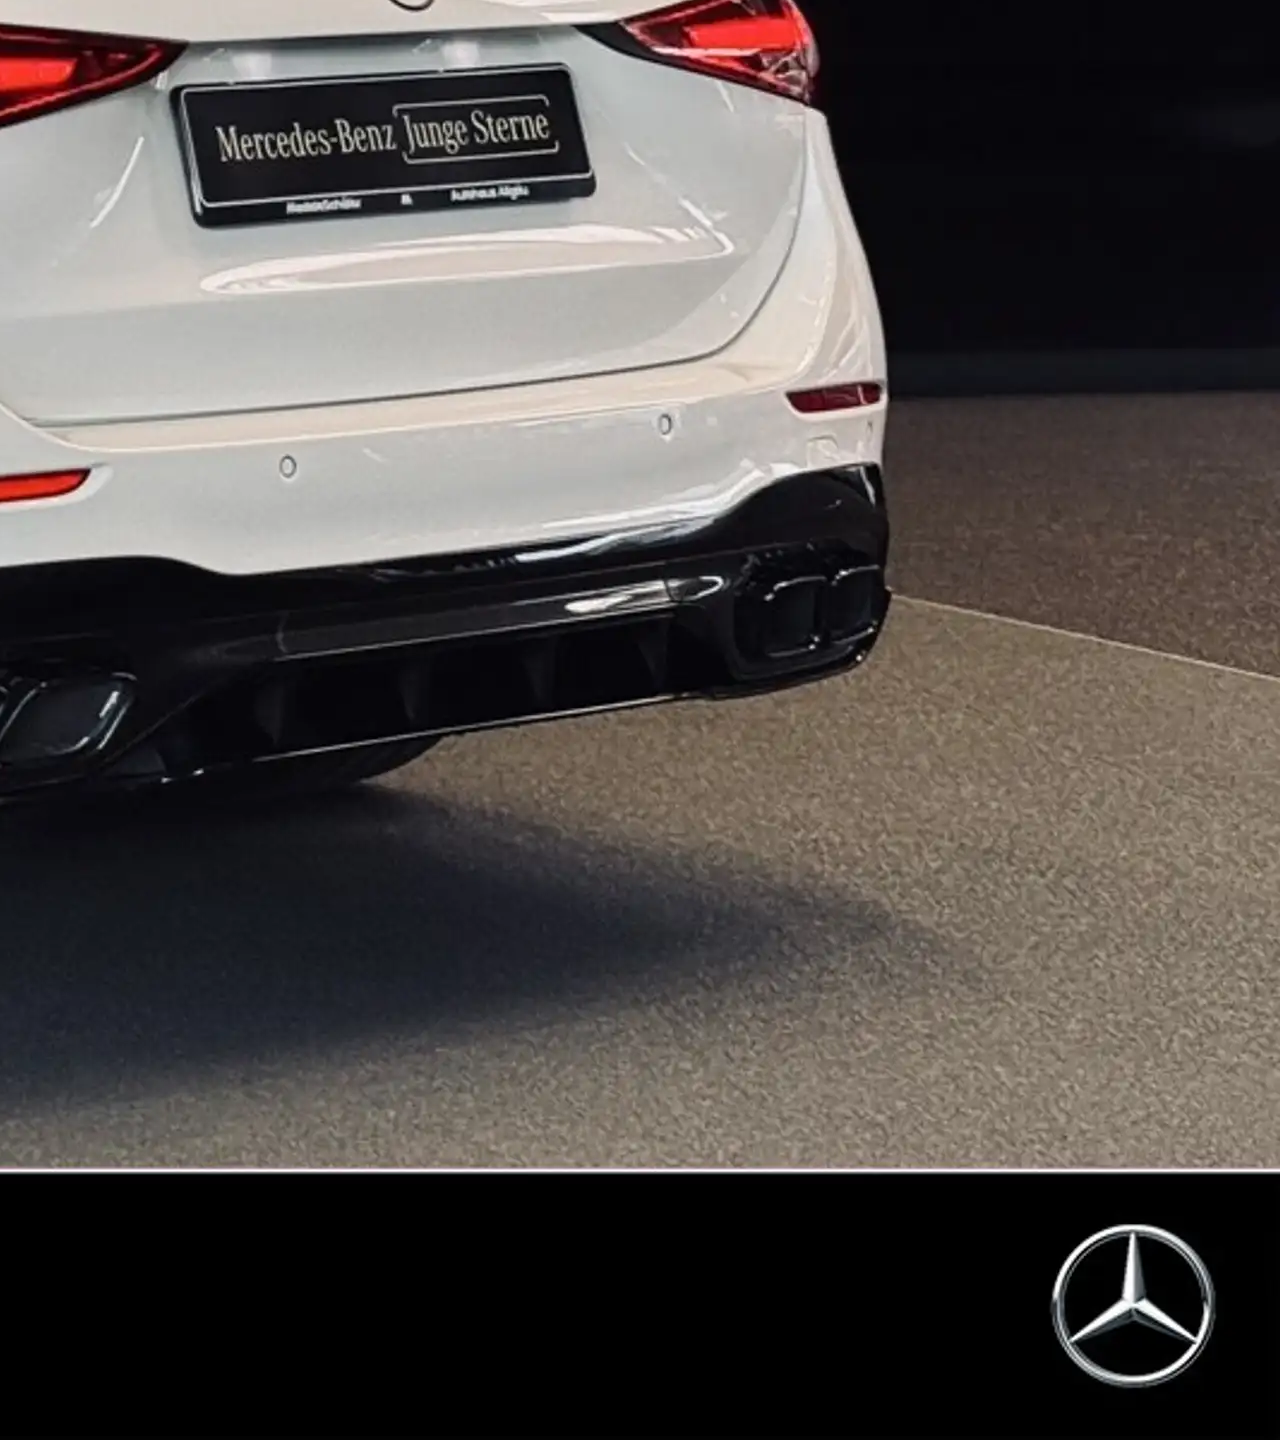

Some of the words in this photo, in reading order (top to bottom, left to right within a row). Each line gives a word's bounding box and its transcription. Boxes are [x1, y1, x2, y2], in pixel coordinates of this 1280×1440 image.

[215, 118, 397, 162] Mercedes-Benz
[402, 114, 469, 155] Junge
[471, 110, 550, 144] Sterne
